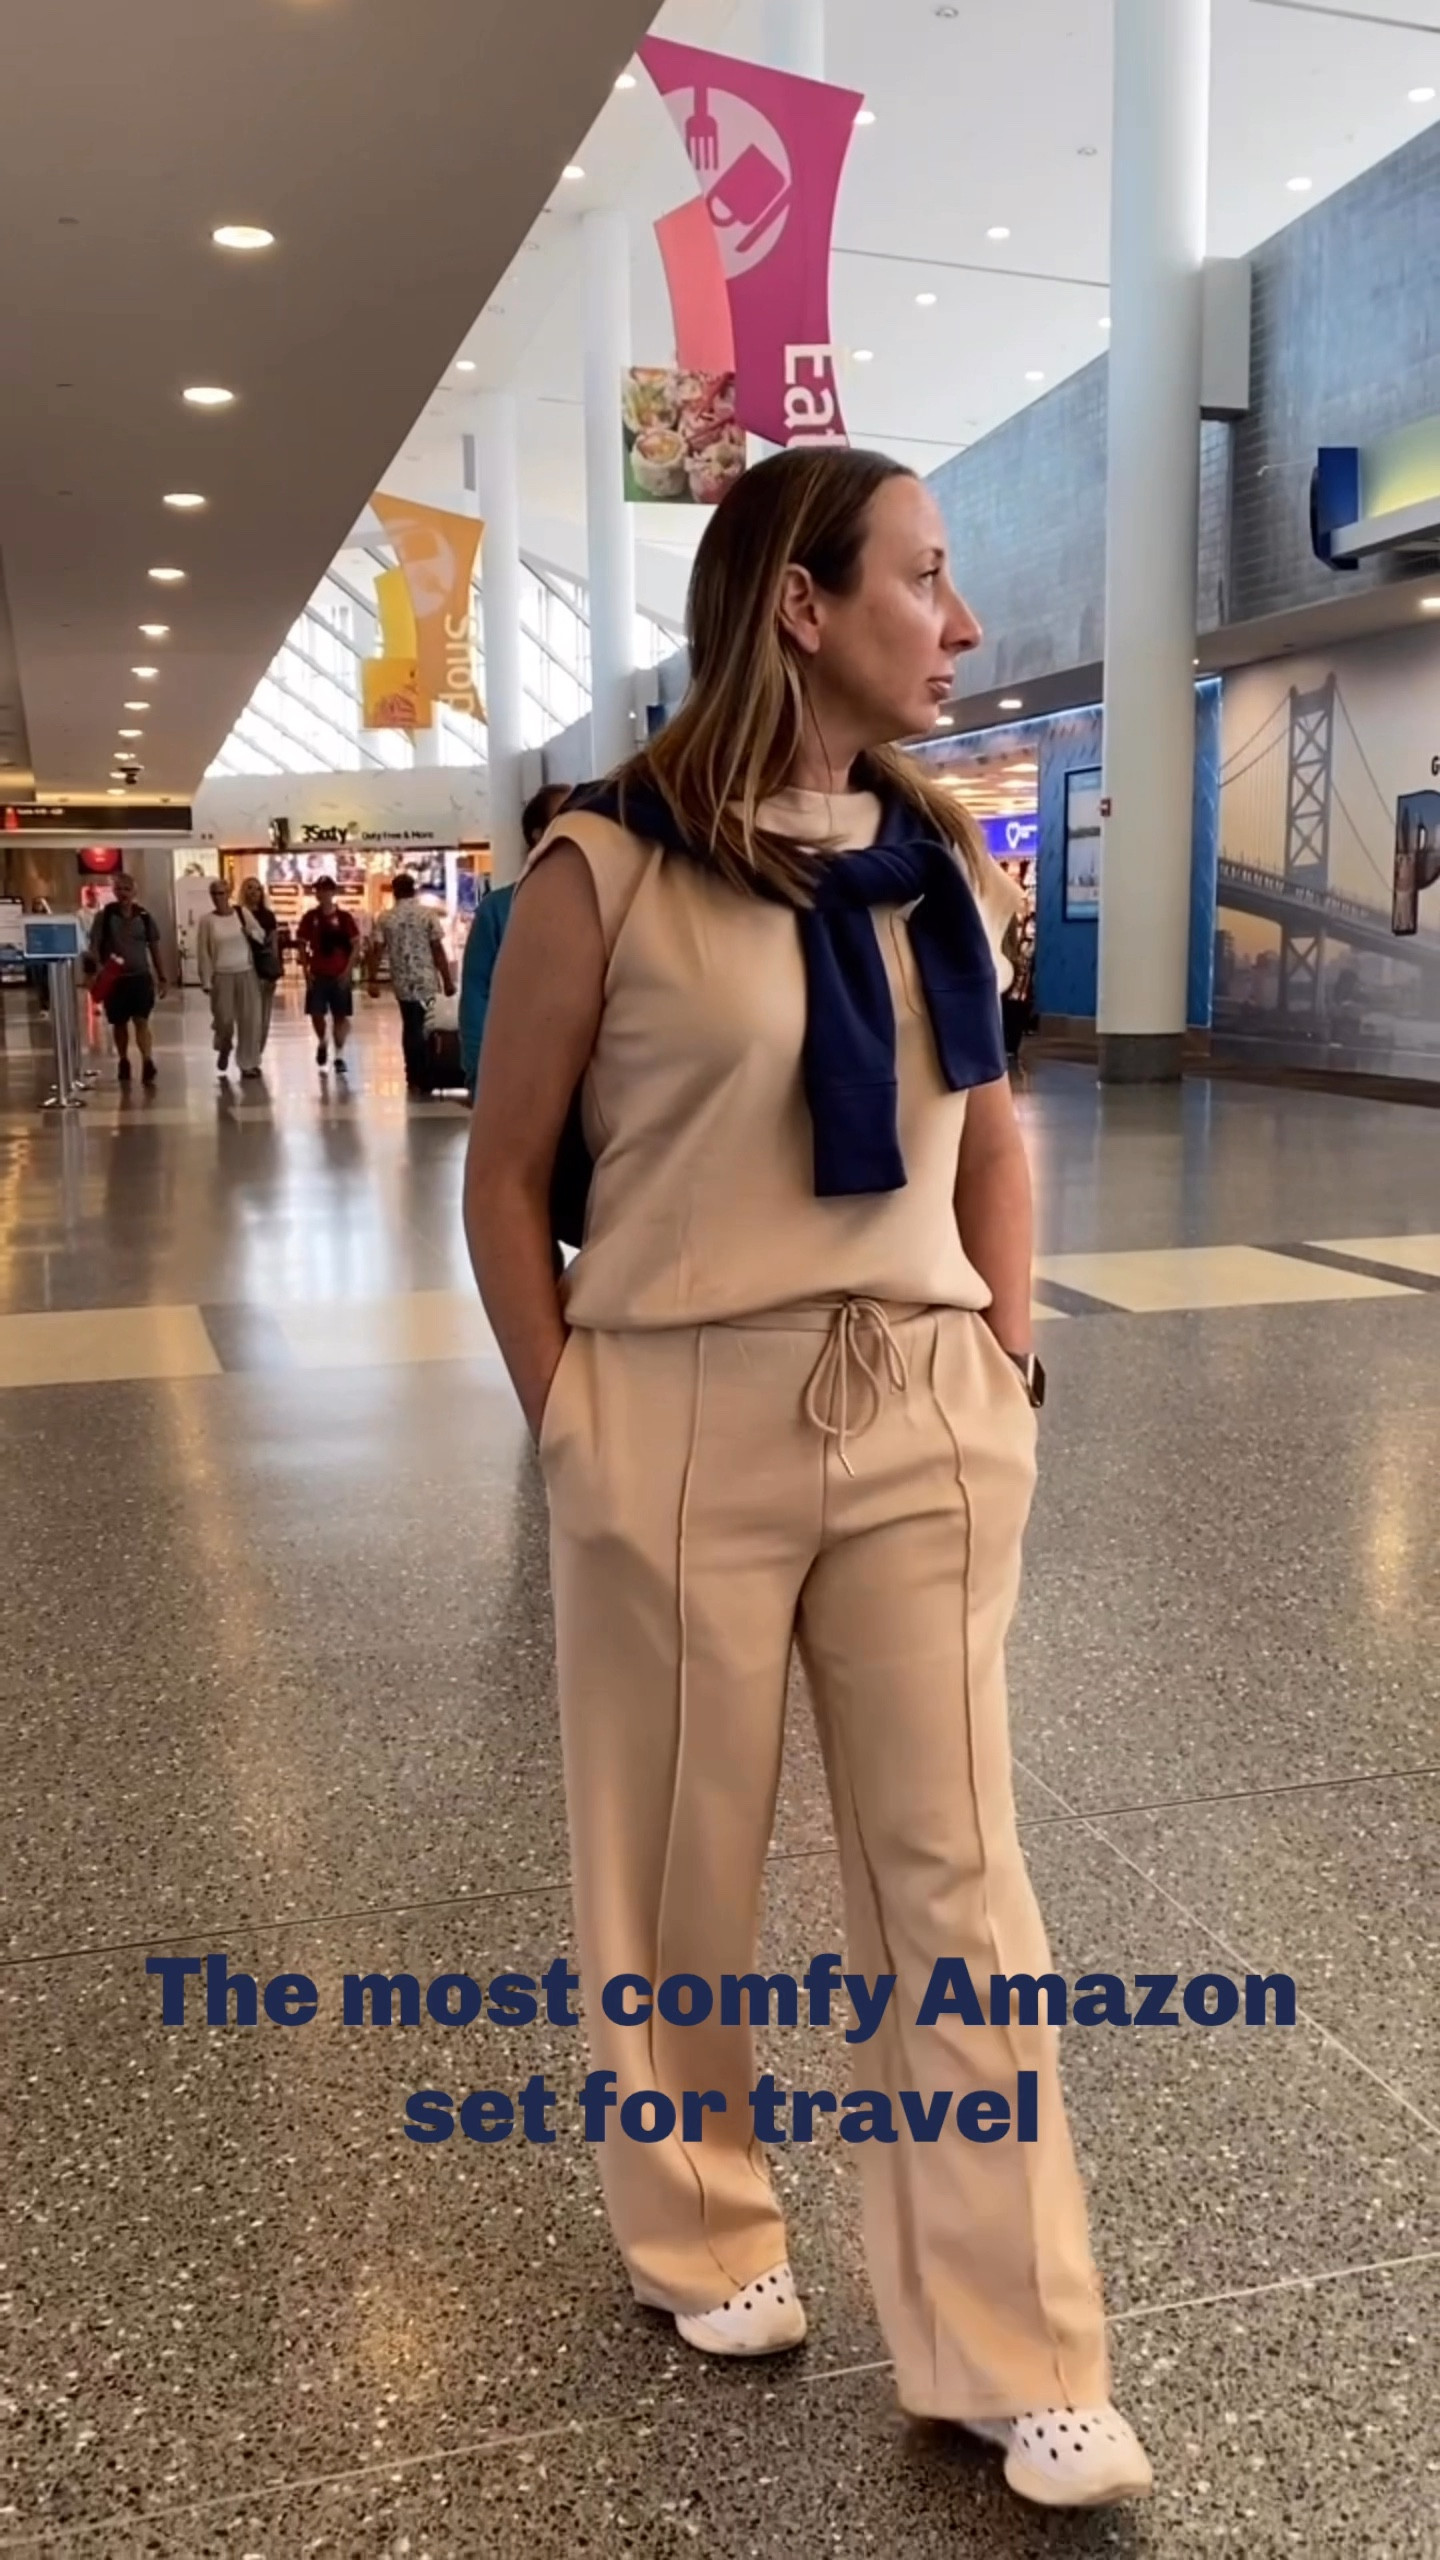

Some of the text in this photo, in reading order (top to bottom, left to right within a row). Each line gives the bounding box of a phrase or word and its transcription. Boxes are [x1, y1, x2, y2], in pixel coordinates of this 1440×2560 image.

[361, 831, 381, 841] Duty
[383, 831, 401, 840] Free
[412, 831, 434, 840] More
